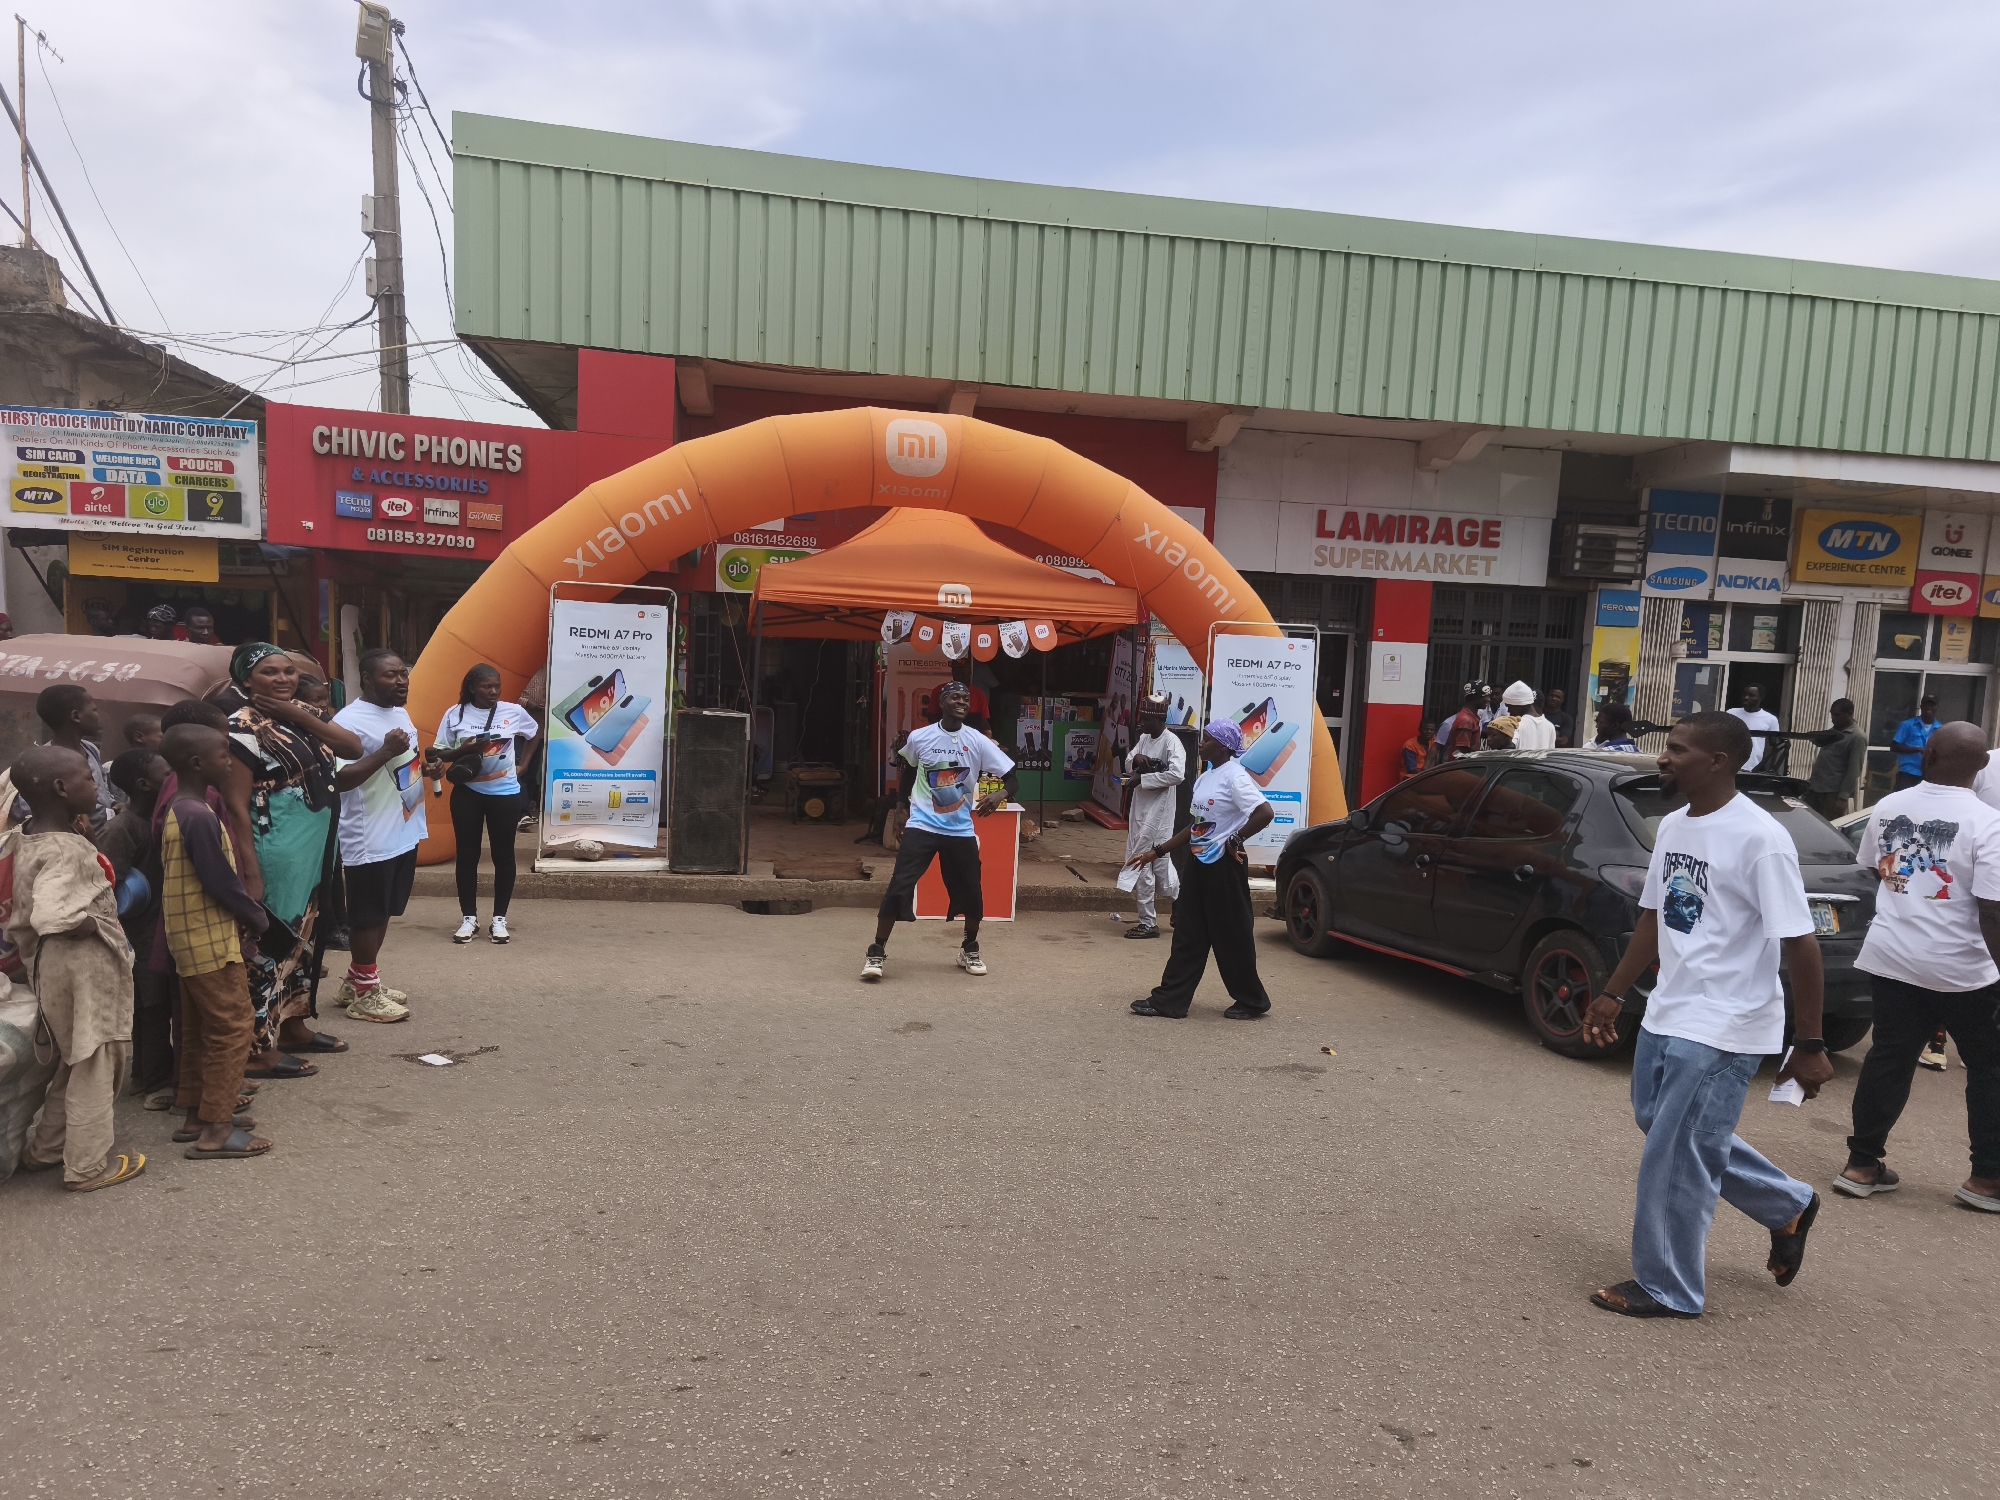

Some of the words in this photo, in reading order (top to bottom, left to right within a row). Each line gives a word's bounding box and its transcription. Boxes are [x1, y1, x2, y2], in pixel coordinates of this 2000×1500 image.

[1, 411, 37, 426] FIRST
[40, 413, 87, 429] CHOICE
[90, 416, 185, 437] MULTIDYNAMIC
[187, 423, 248, 440] COMPANY
[13, 434, 47, 444] Dealers
[49, 436, 63, 445] On
[65, 438, 78, 446] All
[80, 438, 104, 448] Kinds
[122, 441, 148, 450] Phone
[203, 446, 223, 456] Such
[312, 425, 406, 461] CHIVIC
[414, 434, 523, 473] PHONES
[25, 448, 46, 461] SIM
[48, 450, 77, 462] CARD
[95, 454, 134, 466] WELCOME
[135, 457, 158, 467] BACK
[43, 465, 60, 473] SIM
[179, 458, 223, 472] POUCH
[22, 471, 81, 480] REGISTRATION
[105, 469, 148, 484] DATA
[174, 475, 229, 488] CHARGERS
[351, 466, 365, 482] &
[369, 469, 490, 495] ACCESSORIES
[23, 490, 54, 501] MTN
[878, 483, 949, 499] xiaomi
[84, 502, 113, 513] airtel
[147, 496, 166, 509] glo
[205, 492, 224, 516] 9
[386, 500, 407, 512] itel
[424, 506, 459, 519] Infinix
[156, 523, 174, 531] God
[1316, 509, 1502, 549] LAMIRAGE
[1651, 512, 1718, 533] TECNO
[1726, 521, 1787, 536] Infinix
[366, 527, 476, 549] 08185327030
[563, 488, 692, 578] xiaomi
[733, 531, 817, 547] 08161452689
[1826, 528, 1892, 552] MTN
[101, 543, 120, 552] SIM
[122, 545, 185, 556] Registration
[1931, 546, 1974, 559] GIONEE
[126, 555, 161, 564] Center
[1313, 544, 1498, 577] SUPERMARKET
[728, 561, 749, 577] glo
[1133, 522, 1237, 615] xiaomi
[1806, 561, 1867, 574] EXPERIENCE
[1868, 564, 1907, 576] CENTRE
[1649, 574, 1699, 587] SAMSUNG
[1717, 574, 1782, 592] NOKIA
[1929, 584, 1964, 600] itel
[1601, 603, 1624, 611] FERO
[569, 626, 610, 640] REDMI
[613, 629, 630, 640] A7
[632, 630, 653, 641] Pro
[1227, 658, 1263, 669] REDMI
[1266, 660, 1281, 670] A7
[1283, 661, 1302, 671] Pro
